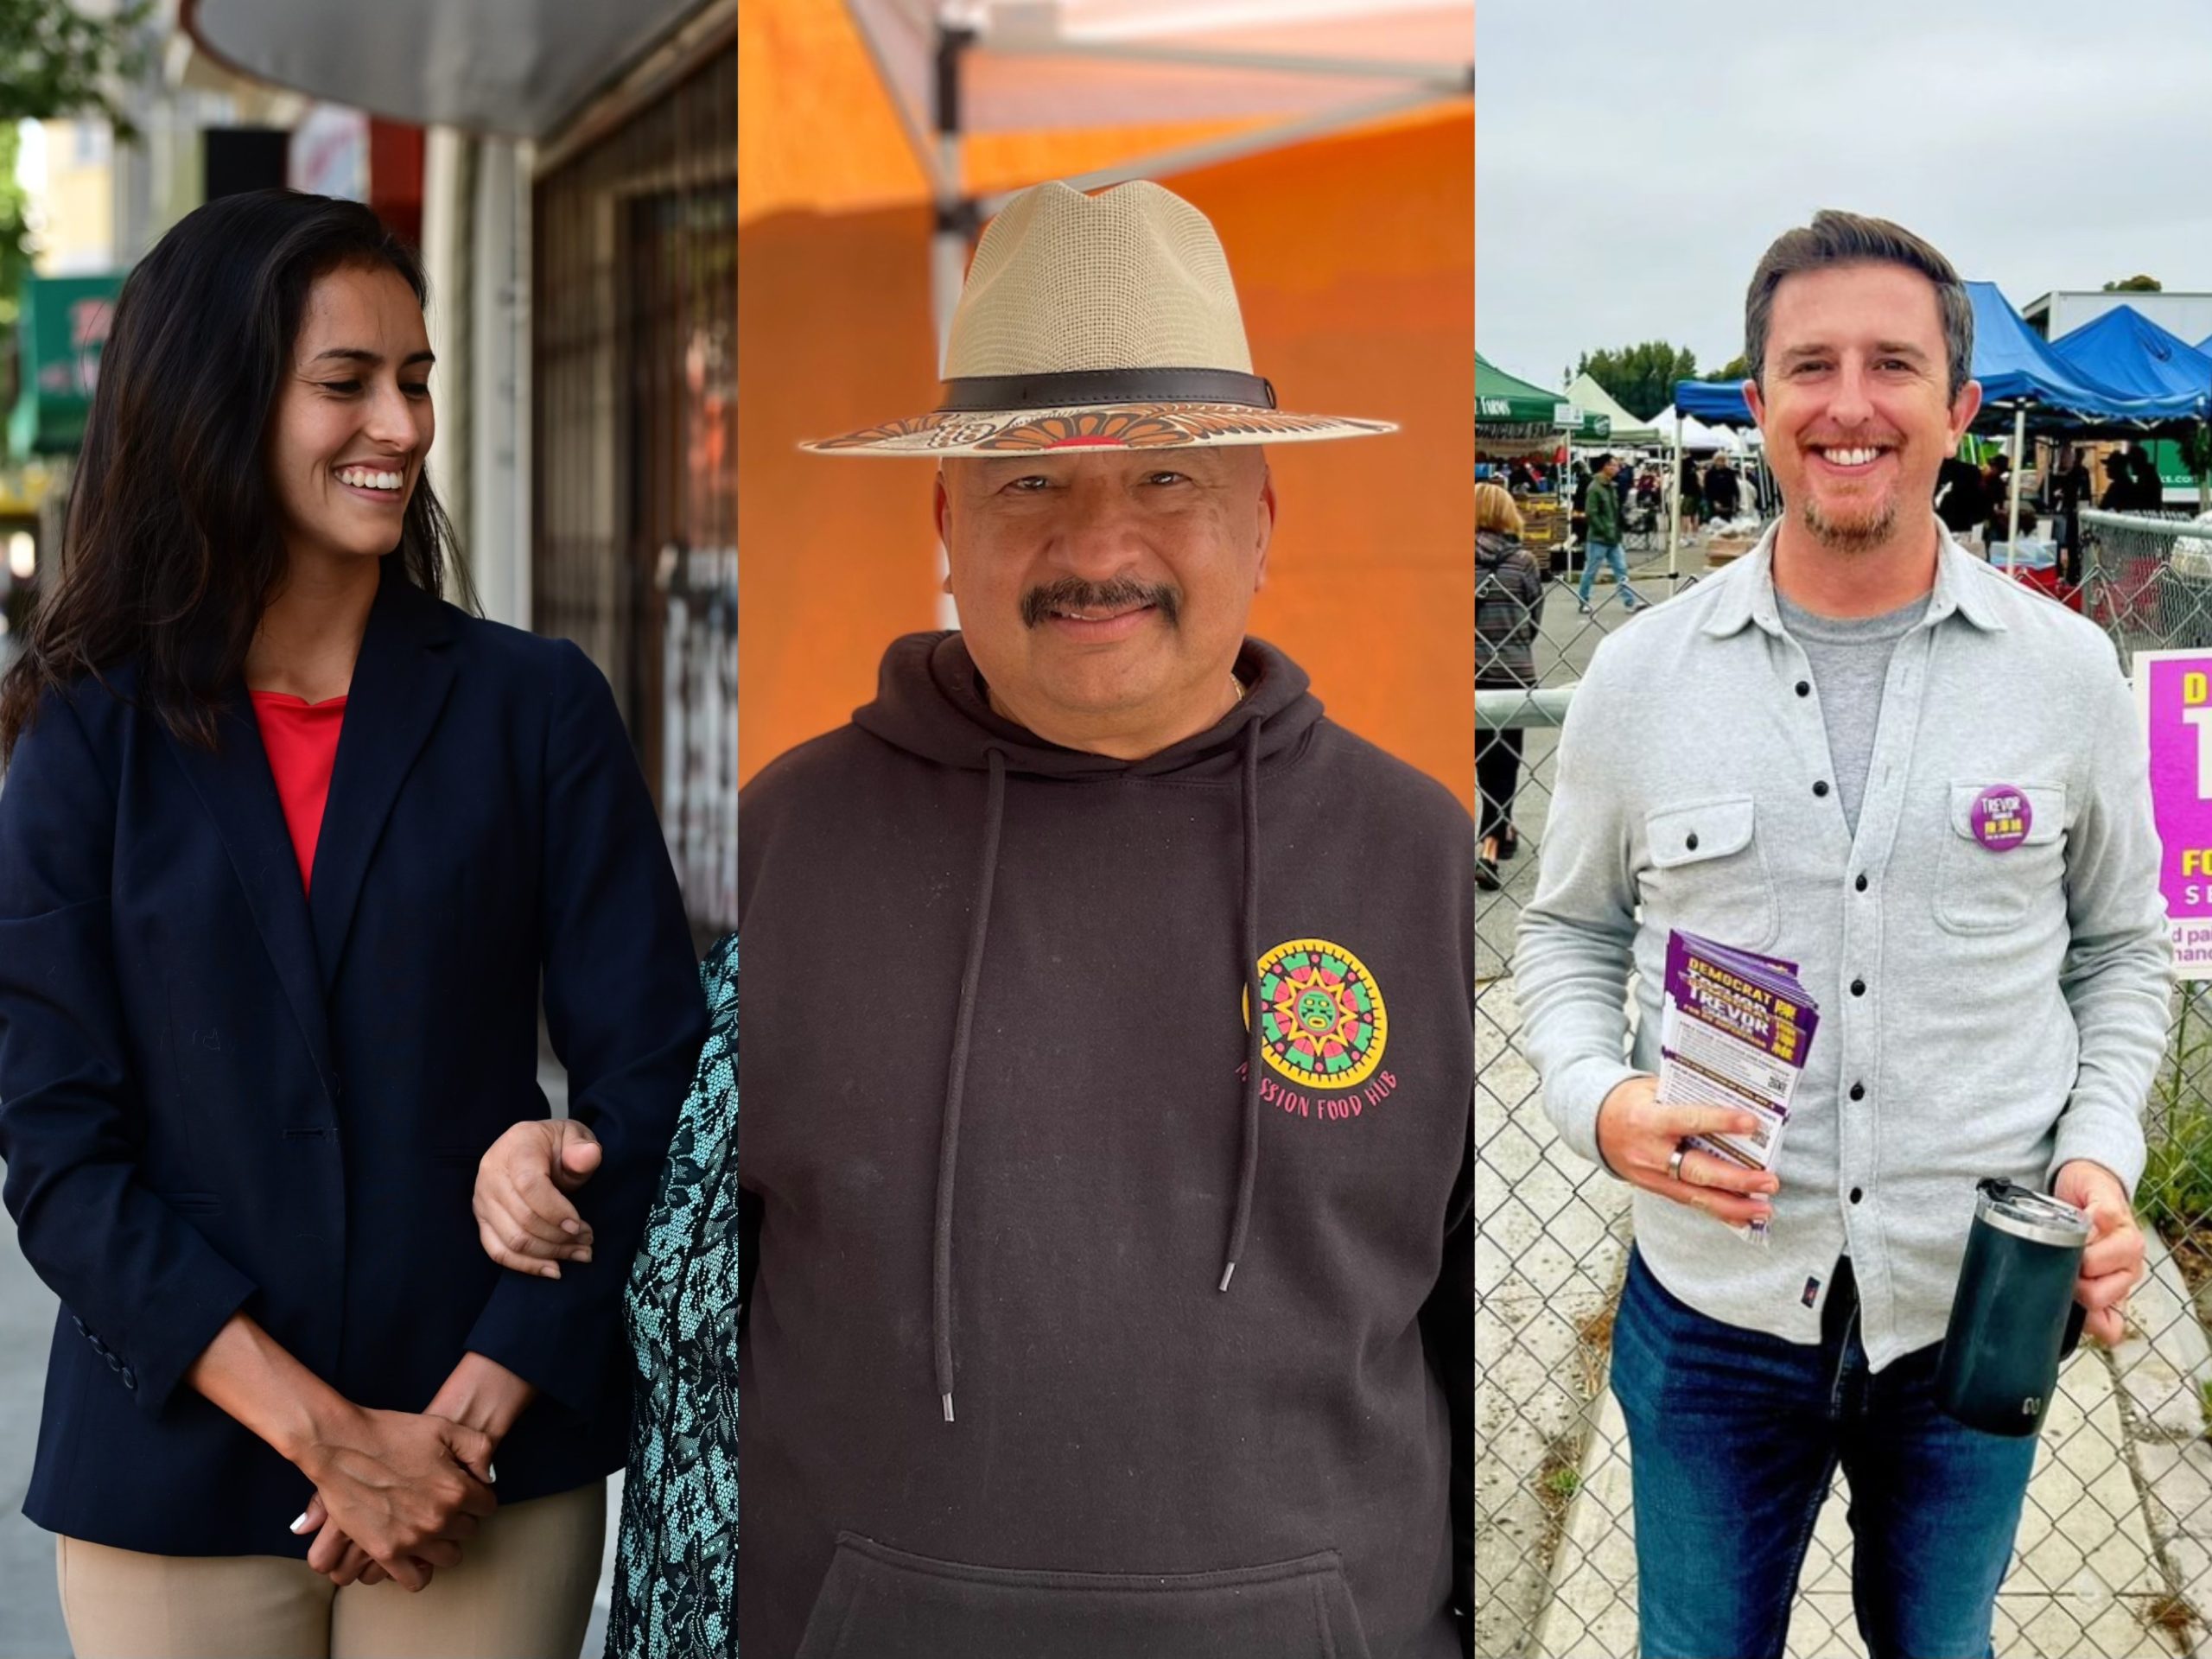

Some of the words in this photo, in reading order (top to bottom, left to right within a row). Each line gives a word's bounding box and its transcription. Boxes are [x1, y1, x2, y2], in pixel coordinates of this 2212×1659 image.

[2188, 928, 2212, 946] pa
[1688, 957, 1772, 1005] DEMOCRAT
[1688, 984, 1770, 1036] TREVOR
[1235, 1061, 1309, 1117] SSION
[1318, 1094, 1363, 1121] FOOD
[1363, 1071, 1397, 1107] HUB
